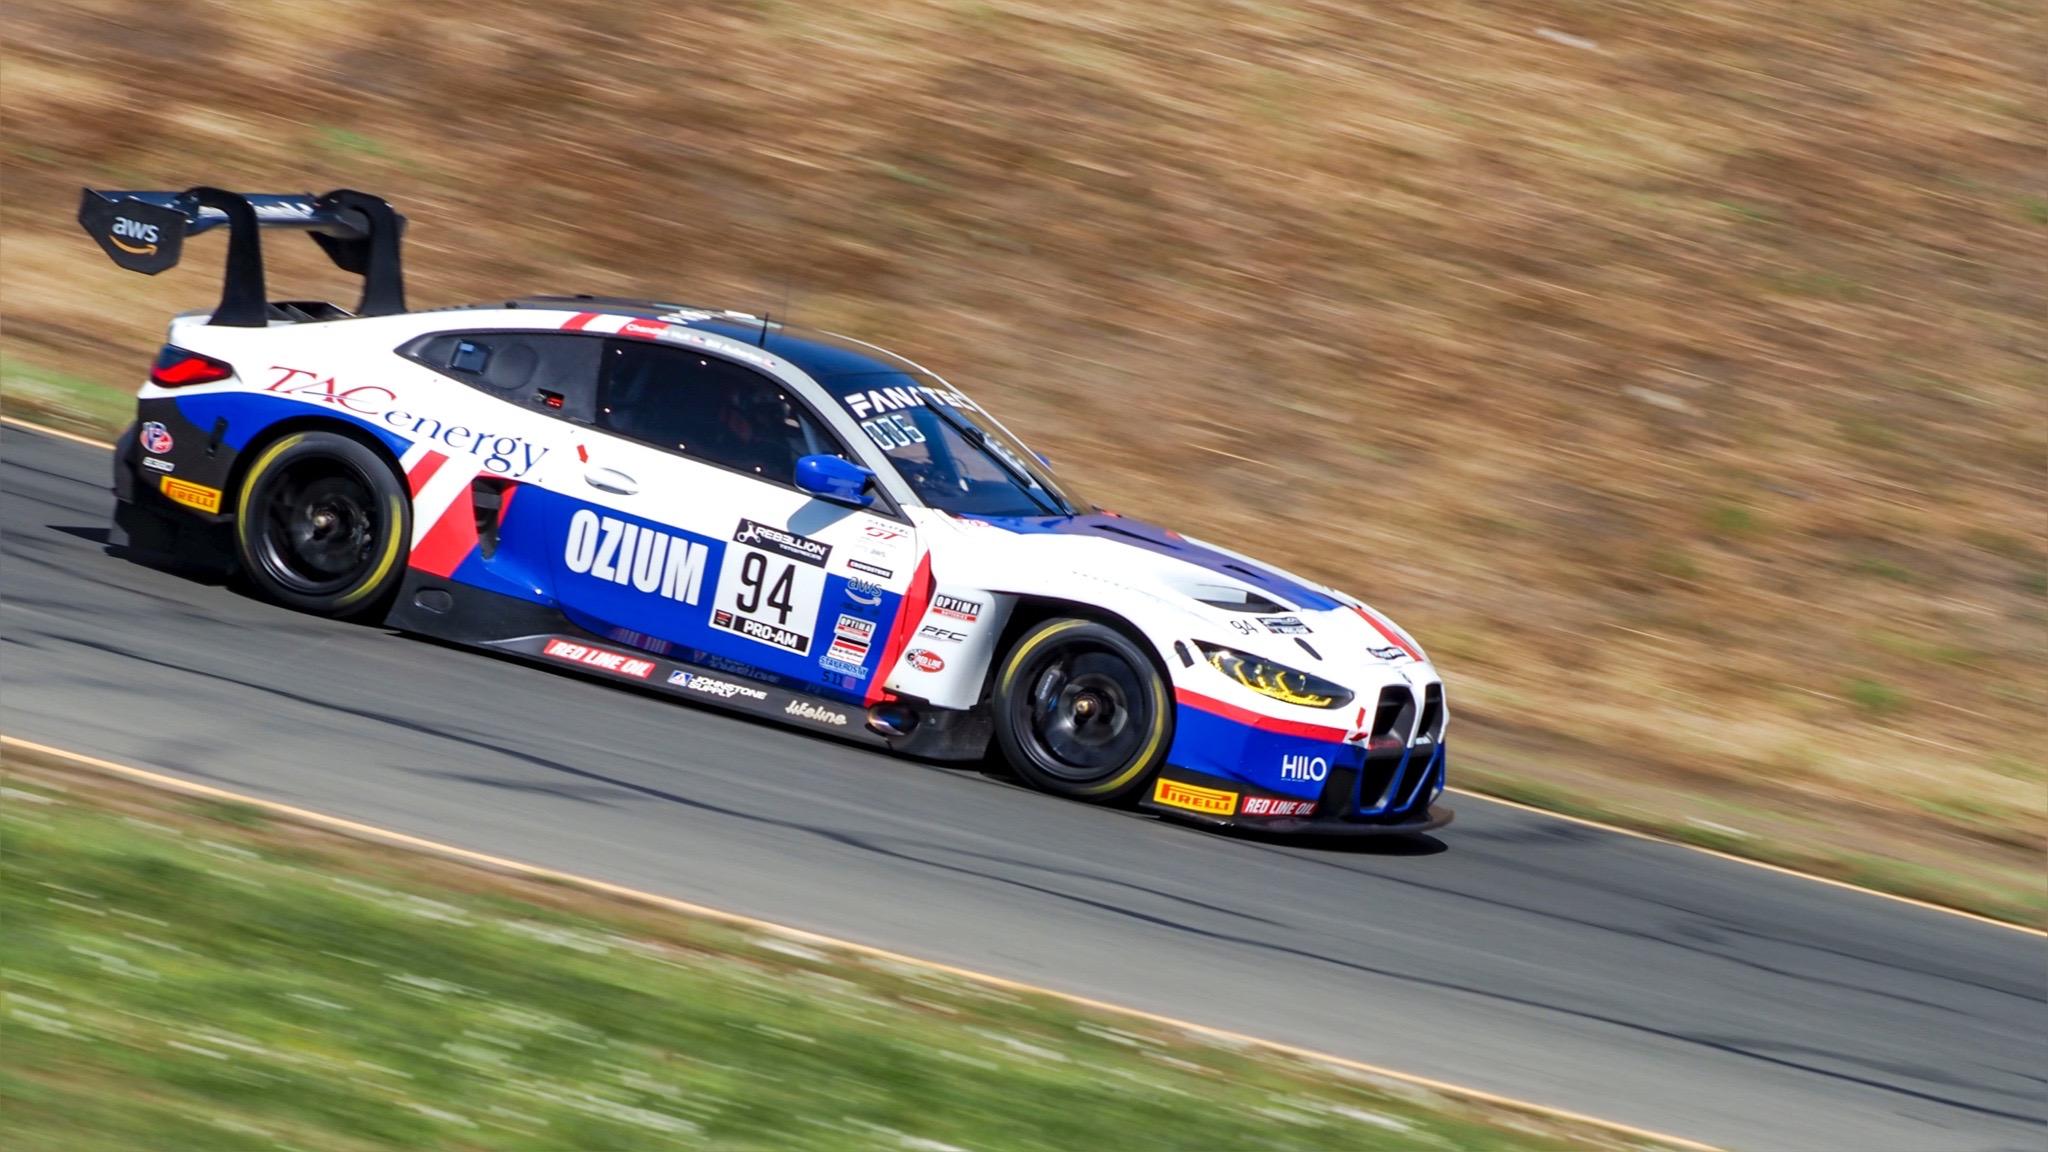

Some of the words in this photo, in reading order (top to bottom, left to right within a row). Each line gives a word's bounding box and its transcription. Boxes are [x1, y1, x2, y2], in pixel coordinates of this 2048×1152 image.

[111, 215, 159, 244] aws
[166, 480, 215, 508] PIRELLI
[564, 509, 709, 606] OZIUM
[736, 551, 797, 625] 94
[847, 576, 882, 597] aws
[935, 595, 980, 615] OPTIMA
[743, 621, 798, 648] PRO-AM
[840, 617, 871, 633] OPTIMA
[921, 625, 968, 642] PFC
[1230, 619, 1258, 635] 94
[548, 641, 588, 660] RED
[583, 649, 626, 670] LINE
[620, 659, 651, 677] OIL
[688, 681, 738, 698] SUPPLY
[692, 676, 768, 700] JOHNSTONE
[1281, 755, 1327, 781] HILO
[1161, 783, 1232, 811] PIRELLI
[1245, 798, 1270, 814] RED
[1269, 800, 1297, 815] LINE
[1295, 803, 1316, 815] OIL
